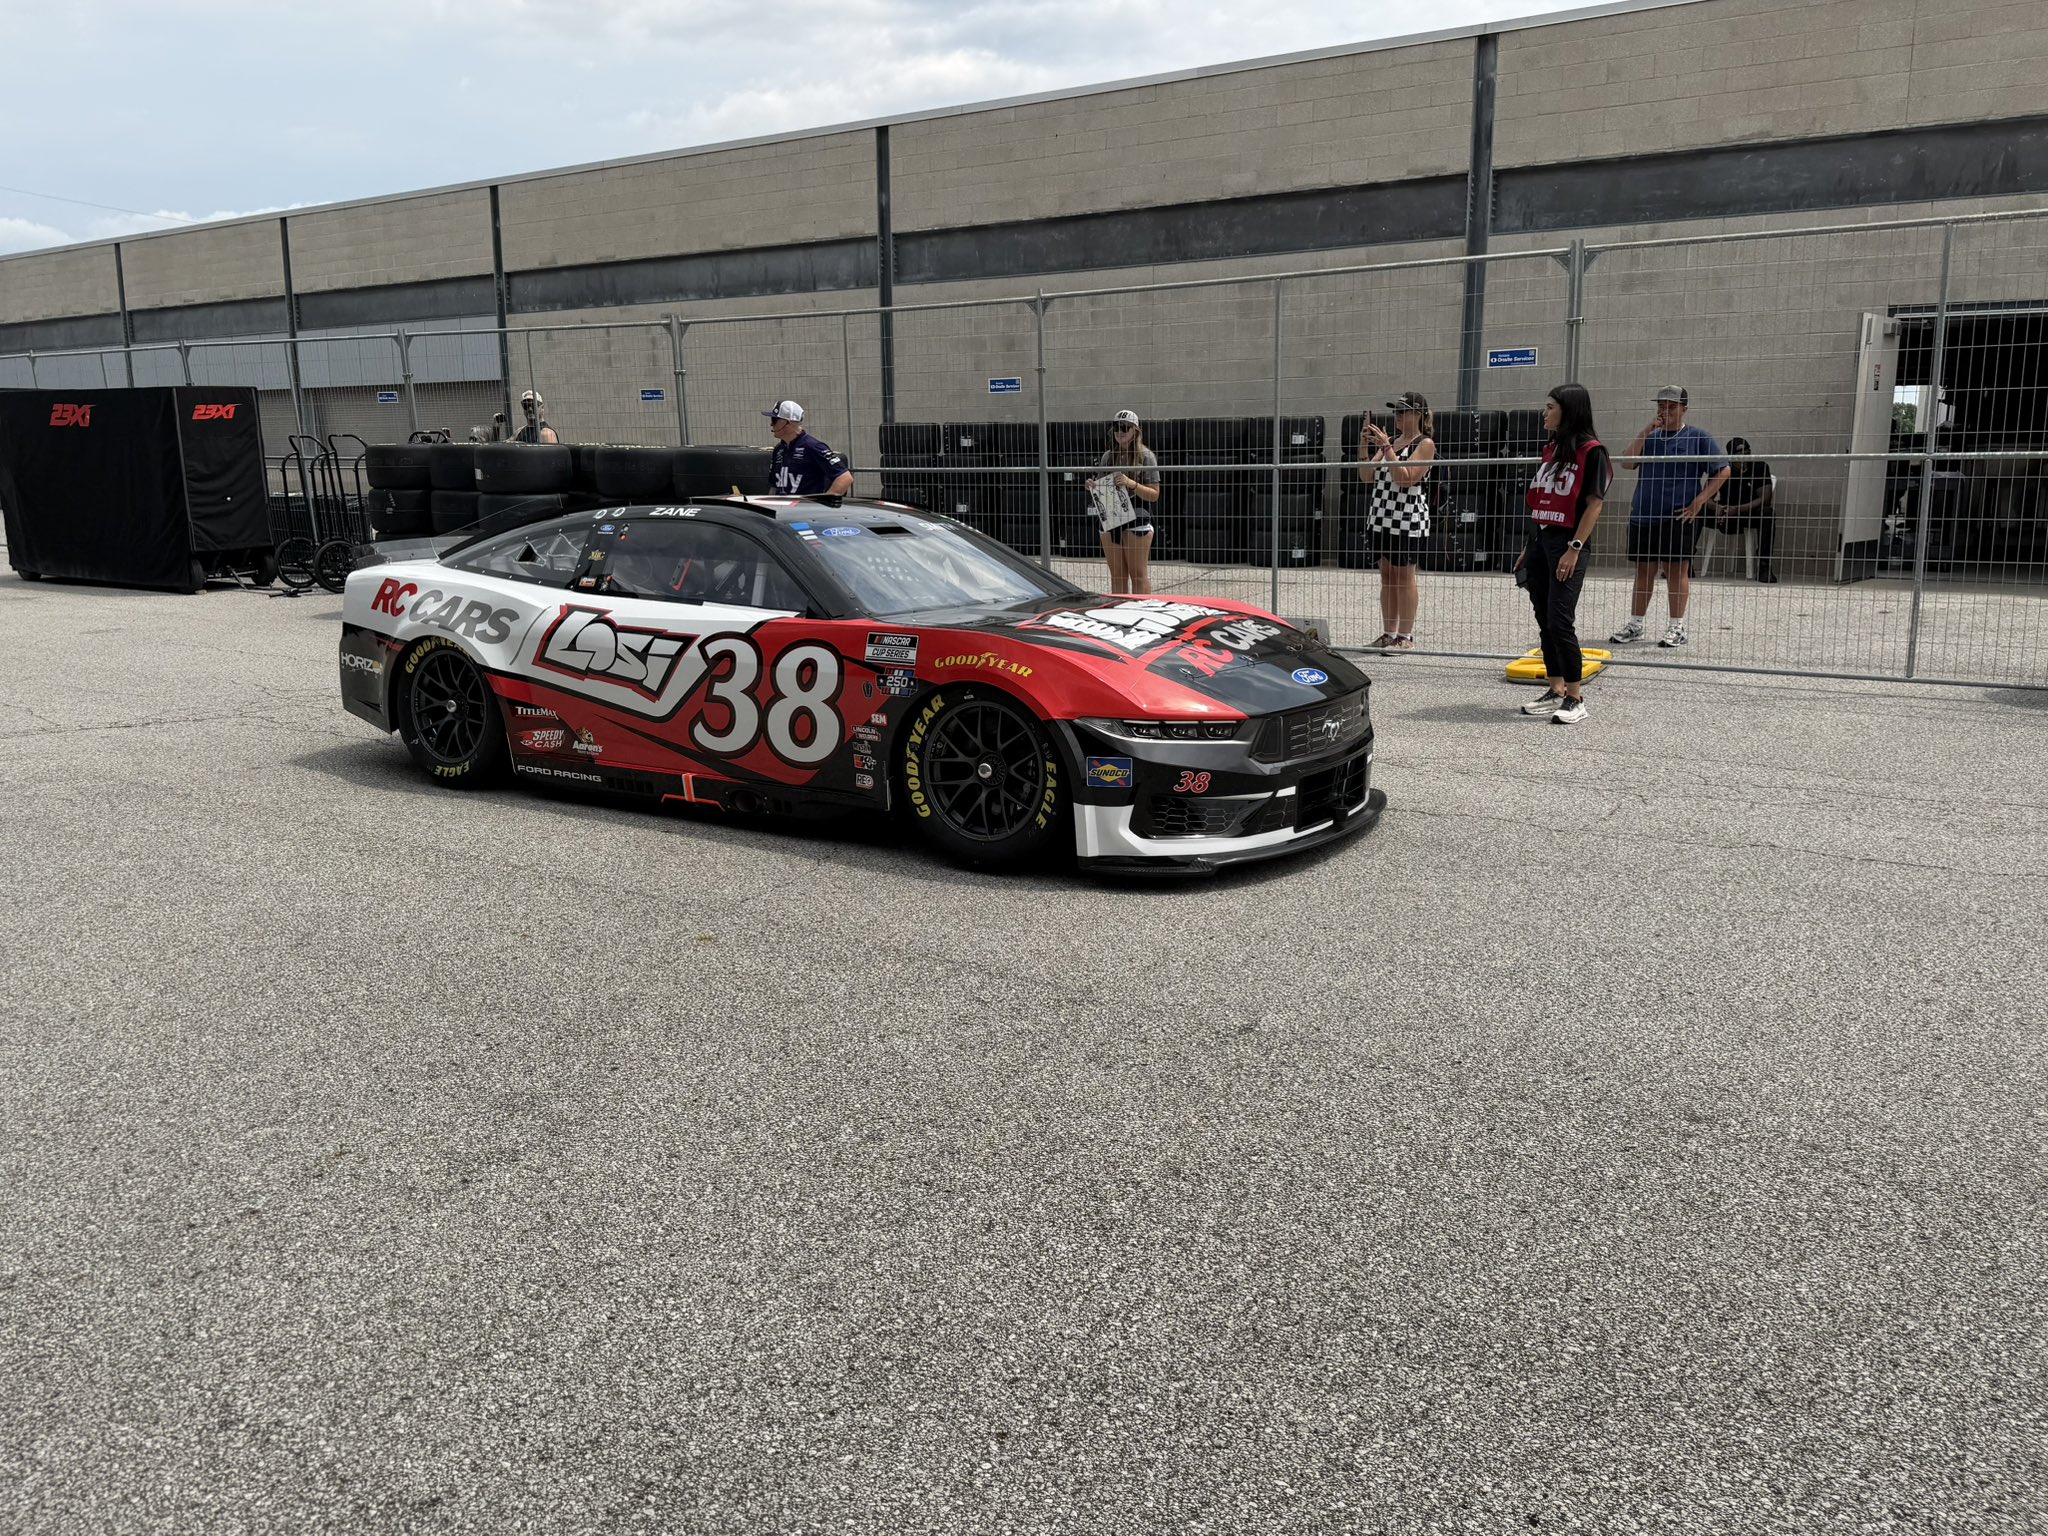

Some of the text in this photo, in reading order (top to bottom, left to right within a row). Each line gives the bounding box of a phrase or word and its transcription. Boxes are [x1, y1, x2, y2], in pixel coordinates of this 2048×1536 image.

[649, 507, 702, 517] ZANE
[371, 577, 520, 645] RC CARS
[882, 636, 911, 646] NASCAR
[871, 647, 910, 659] CUP SERIES
[1176, 639, 1235, 678] RC
[934, 652, 1033, 678] GOODYEAR
[886, 676, 909, 688] 250
[692, 636, 842, 765] 38
[871, 713, 887, 724] SEM
[532, 729, 565, 741] SPEEDY
[534, 740, 563, 748] CASH
[572, 740, 604, 753] Aaron's
[906, 694, 946, 818] GOODYEAR
[517, 764, 603, 783] FORD RACING
[1089, 768, 1129, 777] SUNOCO
[1172, 770, 1212, 794] 38
[1035, 761, 1057, 829] EAGLE
